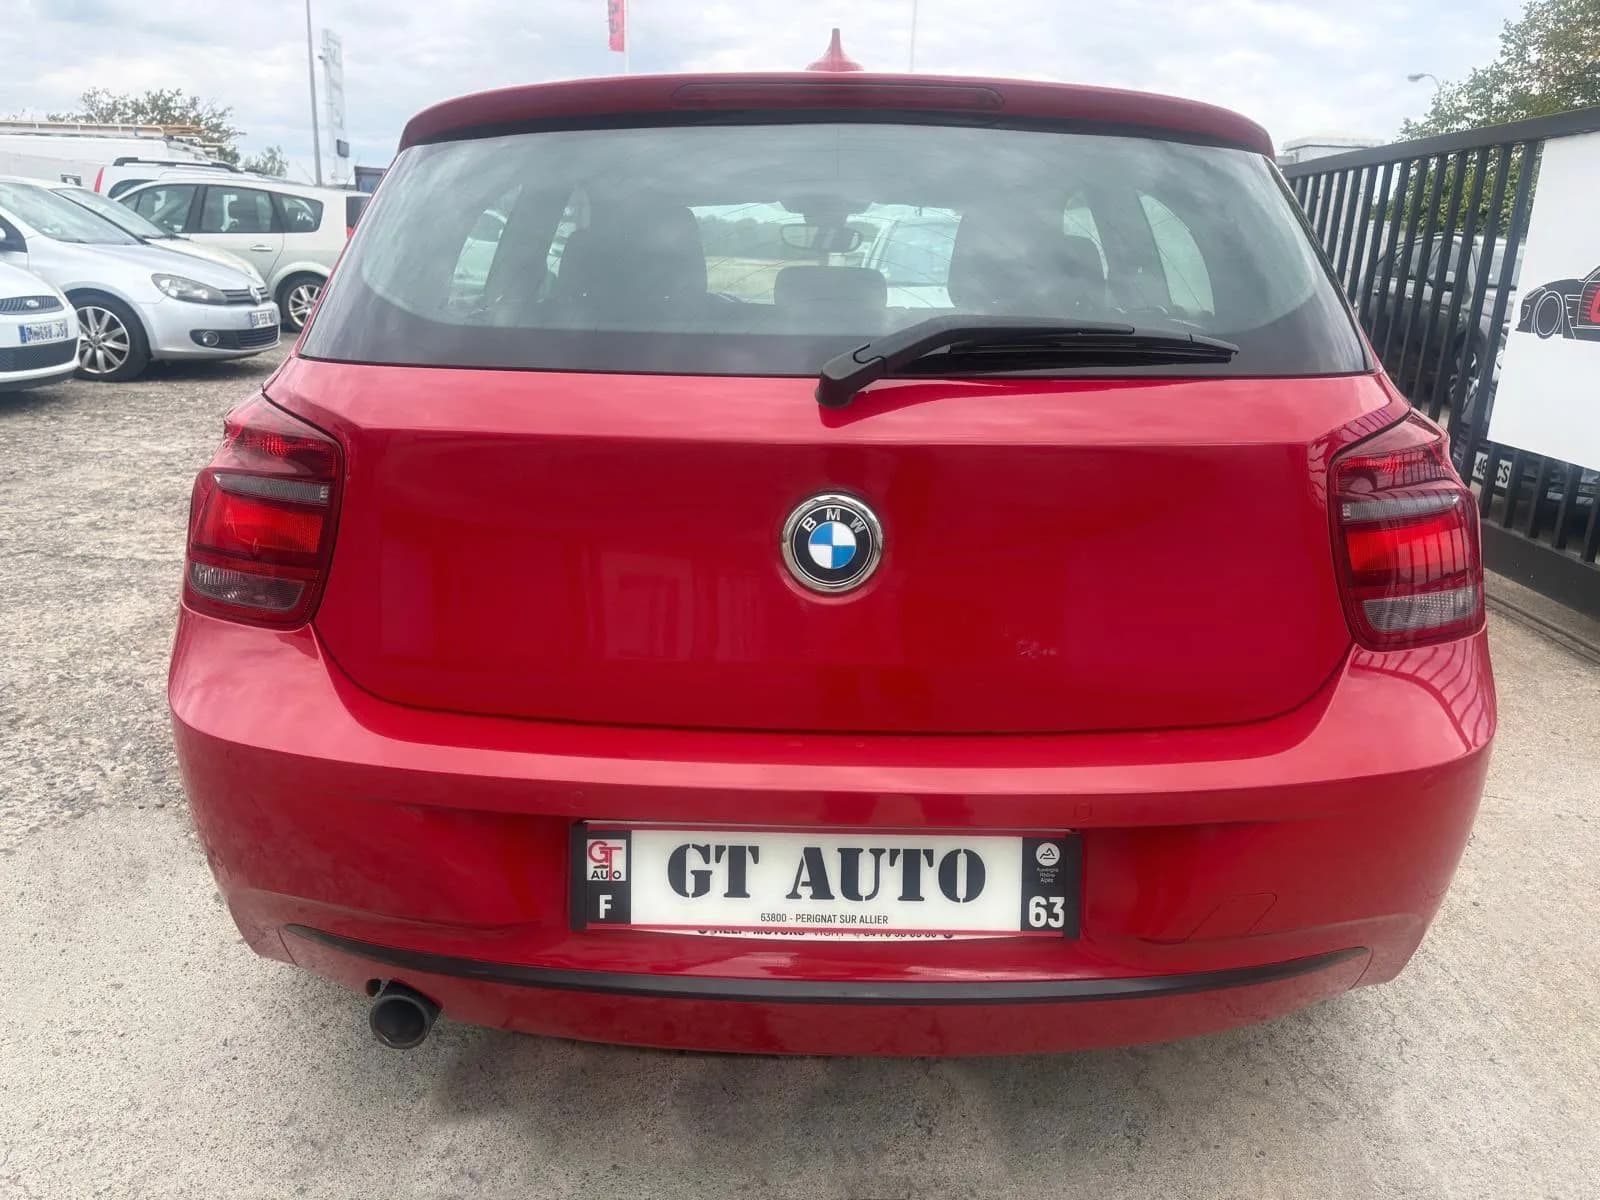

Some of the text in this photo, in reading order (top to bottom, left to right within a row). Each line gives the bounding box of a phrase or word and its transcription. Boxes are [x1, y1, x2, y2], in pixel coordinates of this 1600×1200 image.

[802, 508, 866, 534] BMW
[588, 840, 623, 881] GT
[668, 843, 986, 903] GT AUTO
[599, 894, 613, 919] F
[760, 912, 787, 922] 63800
[795, 913, 837, 924] PERIGNAT
[839, 914, 857, 924] SUR
[859, 914, 889, 925] ALLIER
[1028, 895, 1065, 928] 63
